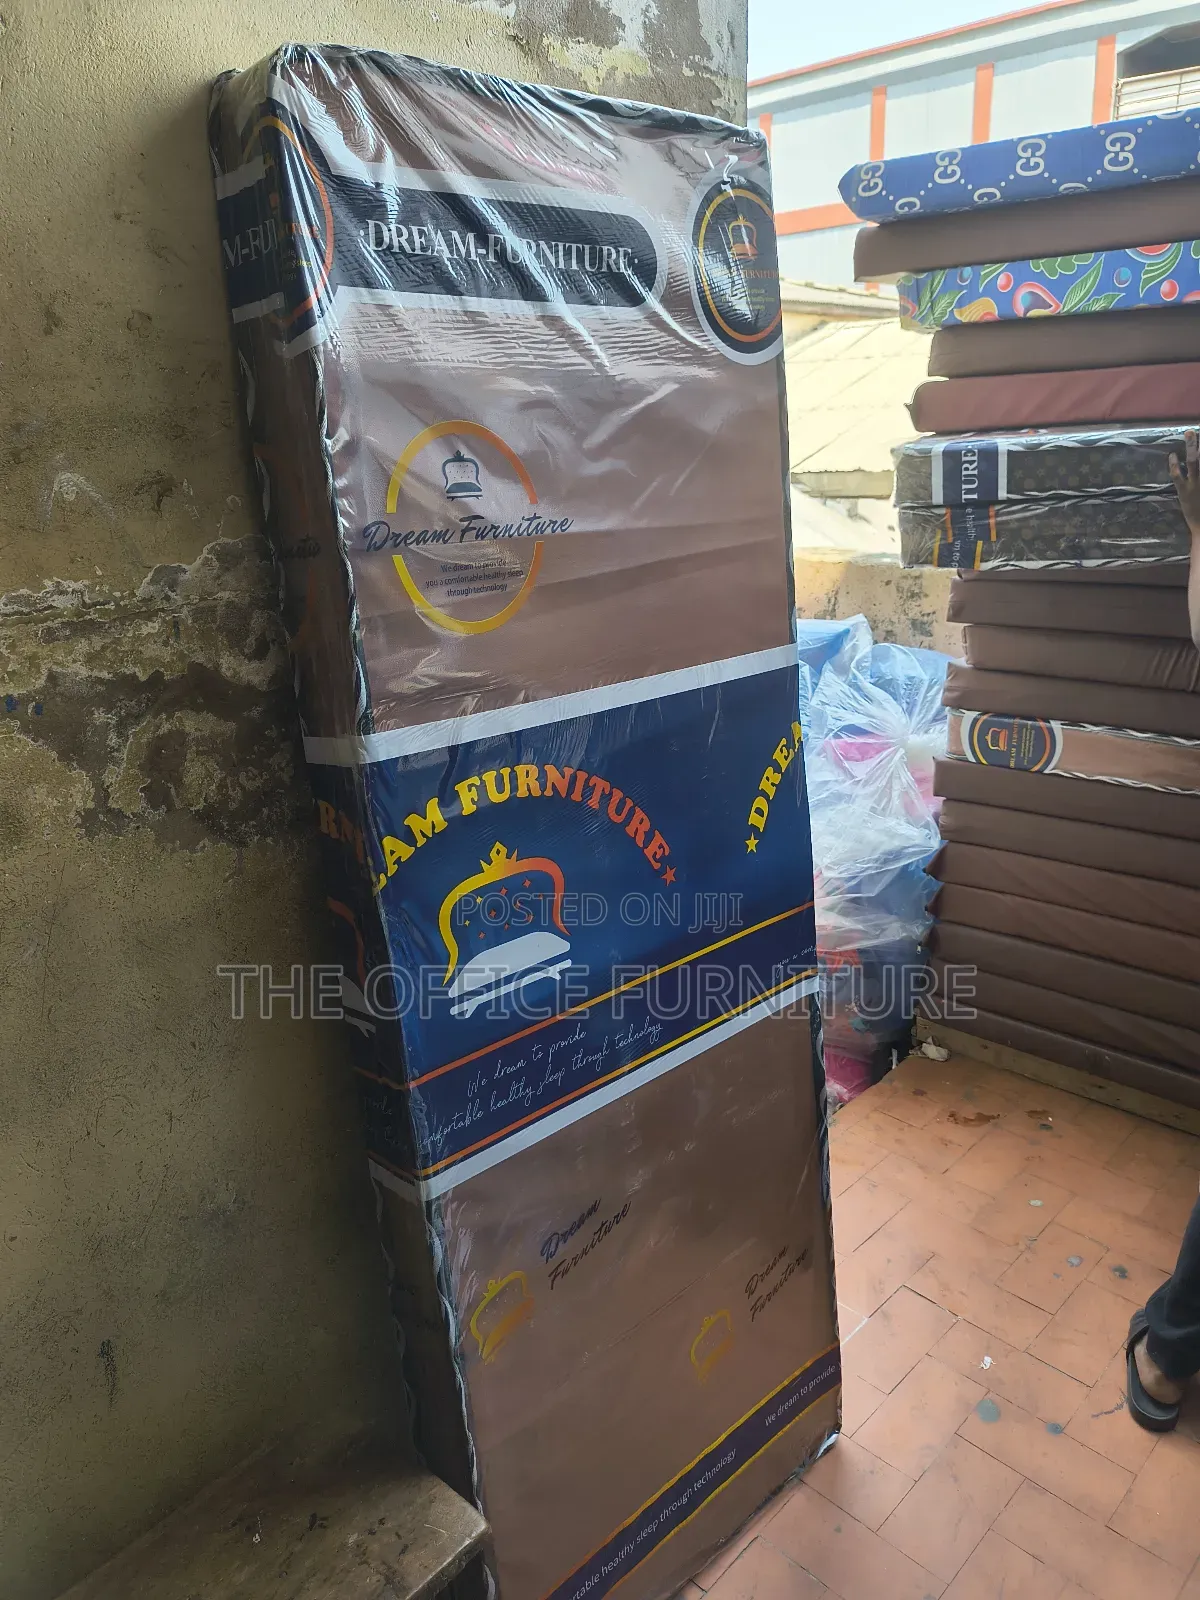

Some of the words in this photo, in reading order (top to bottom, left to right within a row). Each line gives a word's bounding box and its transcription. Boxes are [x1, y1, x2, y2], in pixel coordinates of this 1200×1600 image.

[362, 520, 456, 552] Dream
[459, 512, 574, 544] Furniture
[425, 580, 439, 589] you
[444, 574, 482, 586] comfortable
[483, 570, 506, 581] healthy
[507, 569, 524, 579] sleep
[440, 564, 452, 573] We
[453, 564, 474, 572] dream
[447, 586, 472, 597] through
[473, 582, 508, 594] technology
[454, 763, 671, 869] FURNITURE
[467, 1070, 488, 1097] We
[494, 1059, 529, 1080] dream
[531, 1044, 544, 1060] to
[548, 1023, 587, 1062] provide
[490, 1080, 537, 1106] healthy
[536, 1067, 566, 1095] sleep
[572, 1036, 610, 1072] through
[614, 1016, 664, 1049] technology
[540, 1197, 603, 1264] Dream
[548, 1201, 632, 1291] Furniture
[744, 1245, 790, 1299] Dream
[750, 1248, 809, 1322] Furniture
[764, 1412, 777, 1427] We
[777, 1393, 800, 1416] dream
[800, 1385, 808, 1396] to
[809, 1365, 836, 1392] provide
[600, 1543, 635, 1577] healthy
[636, 1518, 660, 1544] sleep
[660, 1487, 693, 1523] through
[693, 1448, 737, 1492] technology
